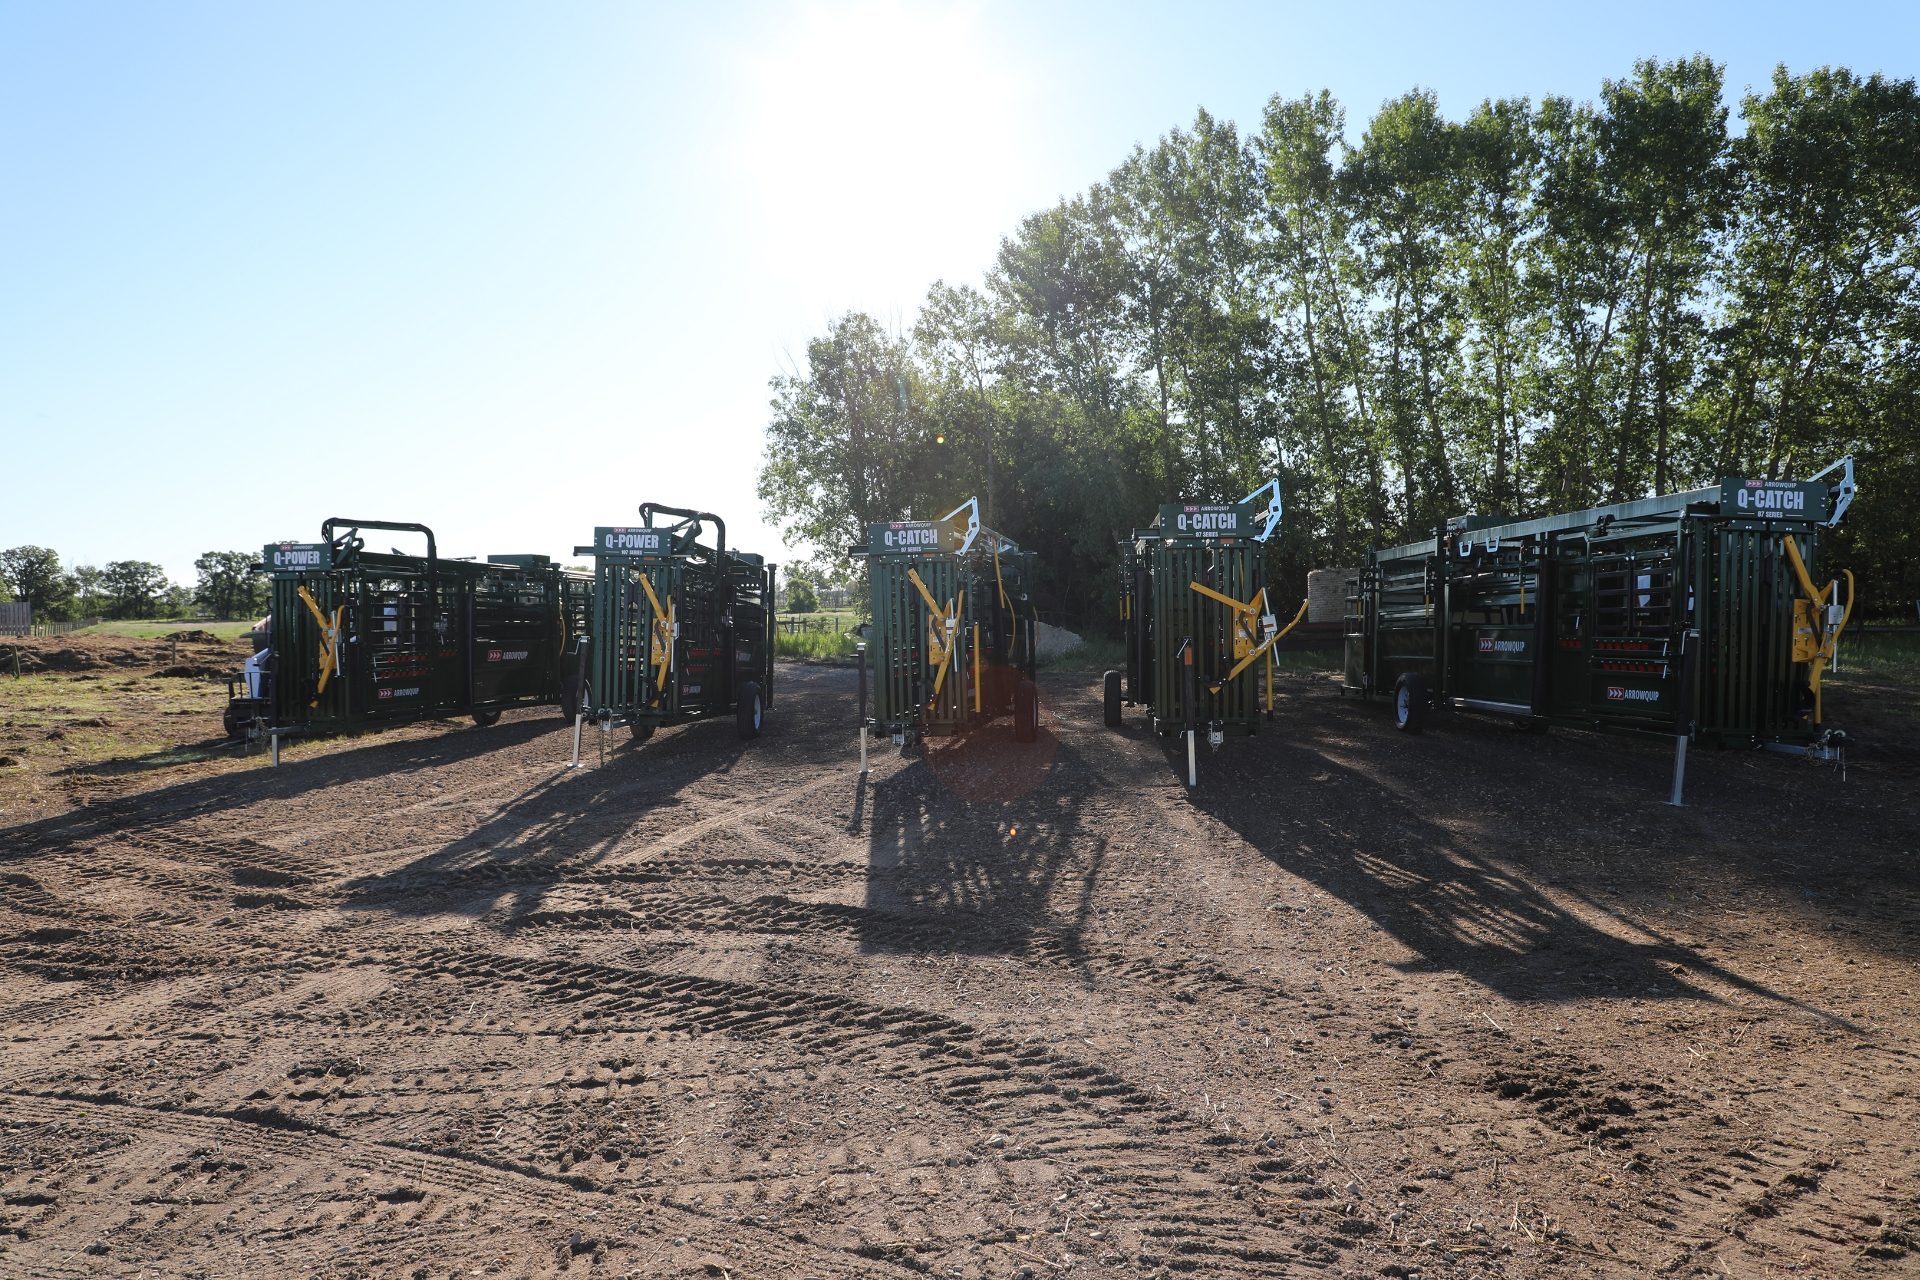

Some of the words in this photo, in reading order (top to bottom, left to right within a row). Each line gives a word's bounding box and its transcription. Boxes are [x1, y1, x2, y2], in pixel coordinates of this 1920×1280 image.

[1737, 488, 1804, 510] Q-CATCH
[1177, 513, 1237, 531] Q-CATCH
[605, 534, 659, 549] Q-POWER
[884, 529, 938, 546] Q-CATCH
[273, 551, 321, 566] Q-POWER
[1494, 640, 1525, 653] ARROWQUIP
[1624, 689, 1660, 702] ARROWQUIP
